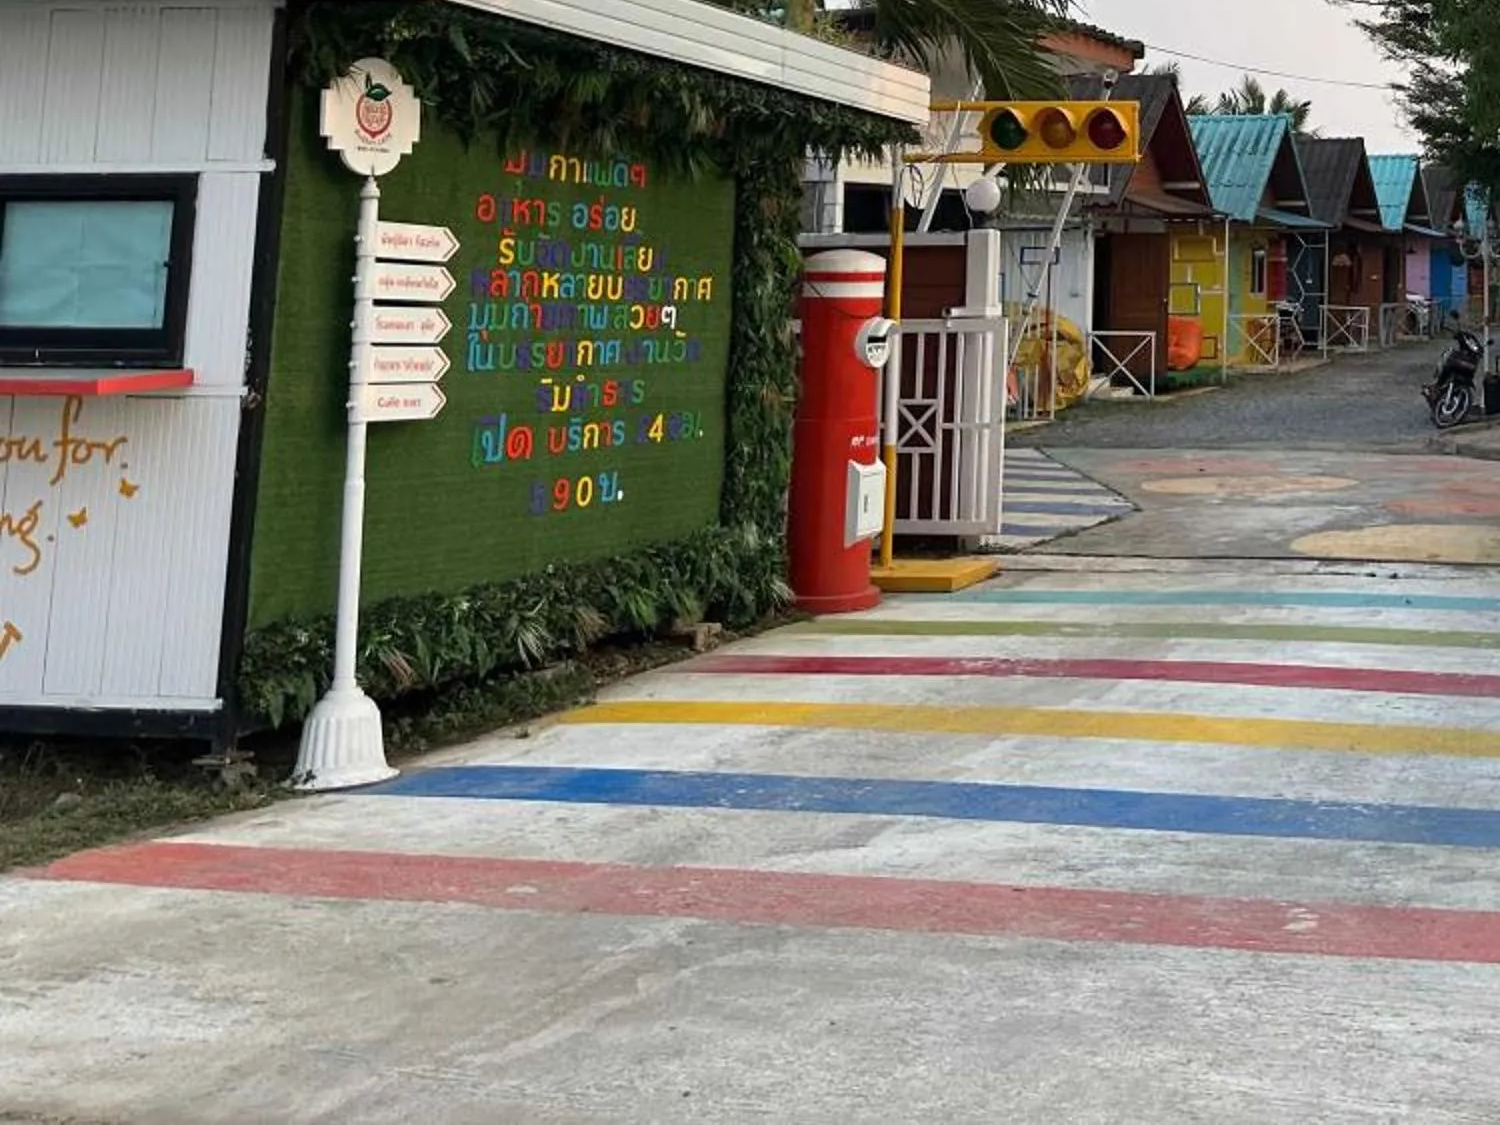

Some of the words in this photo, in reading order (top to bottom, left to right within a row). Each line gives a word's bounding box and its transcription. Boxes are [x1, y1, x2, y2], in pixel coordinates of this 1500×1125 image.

[571, 195, 637, 233] อร่อย
[546, 417, 625, 453] บริการ
